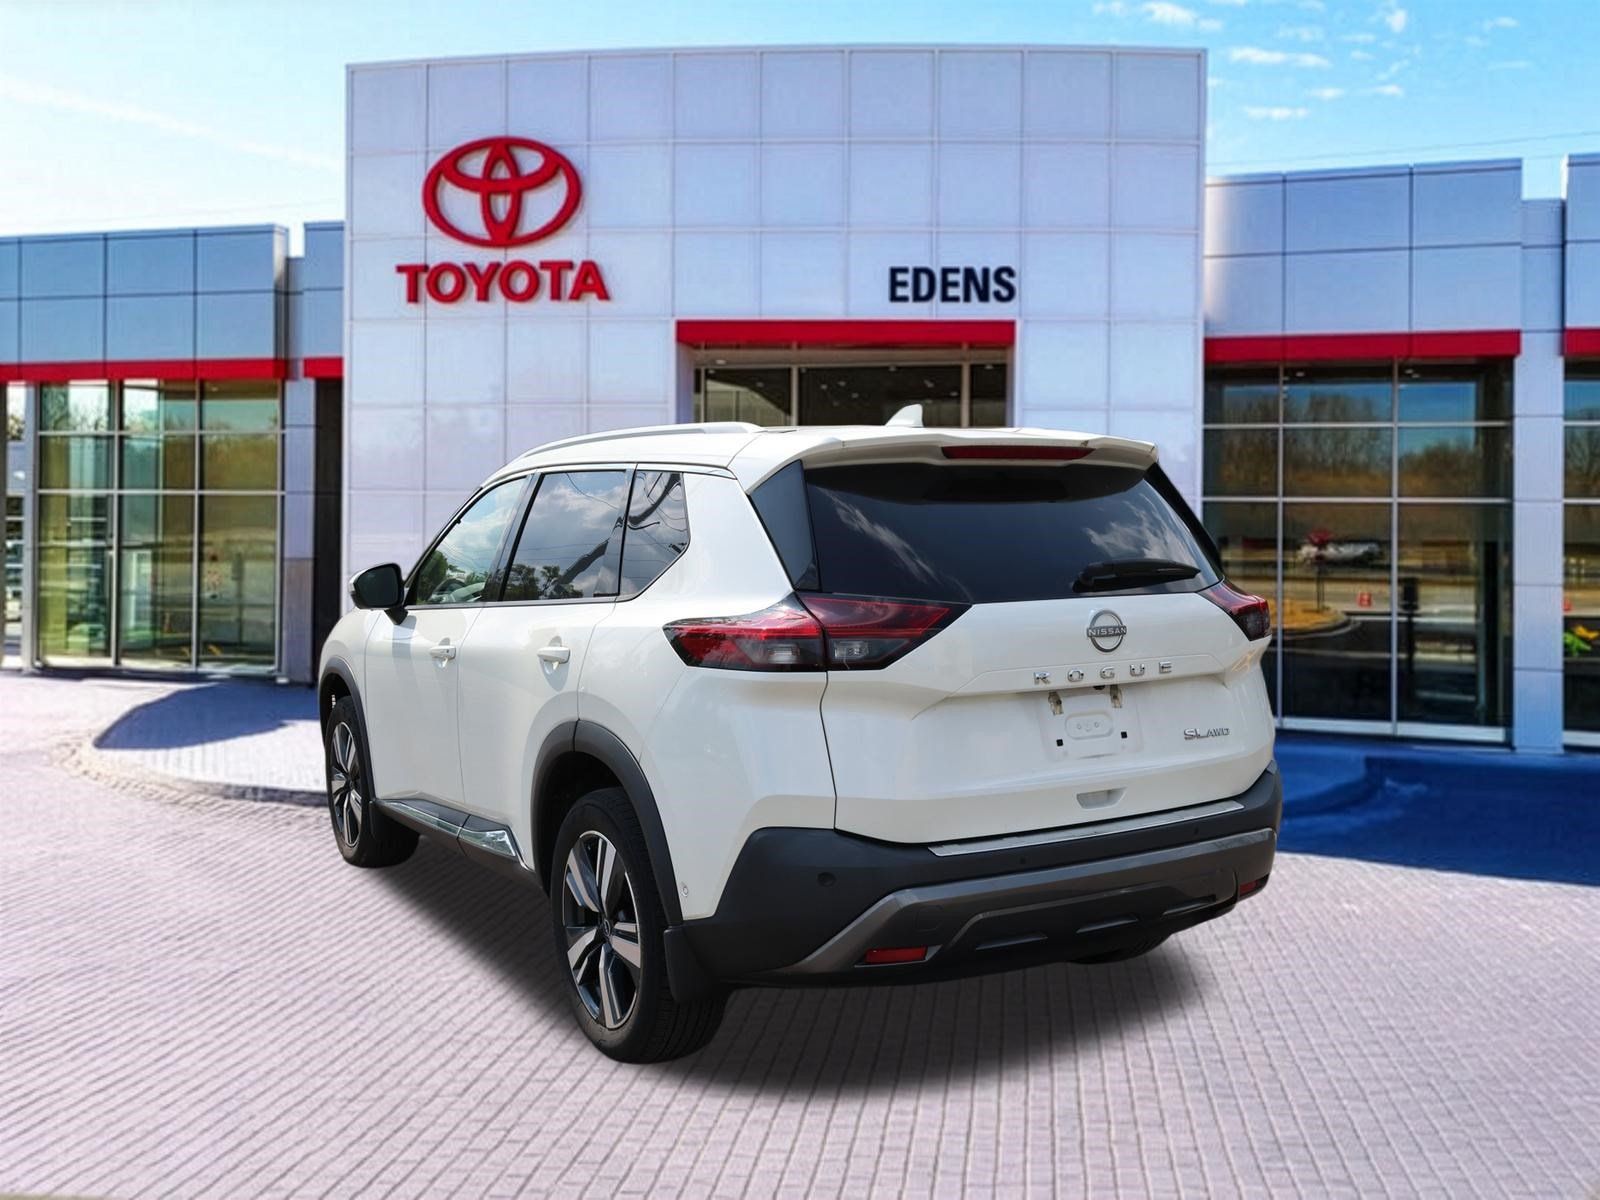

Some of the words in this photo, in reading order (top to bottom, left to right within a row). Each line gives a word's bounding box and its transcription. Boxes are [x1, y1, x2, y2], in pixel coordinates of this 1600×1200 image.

[396, 259, 610, 304] TOYOTA
[889, 265, 1016, 303] EDENS
[1088, 626, 1127, 636] NISSAN
[1034, 661, 1172, 685] ROGUE
